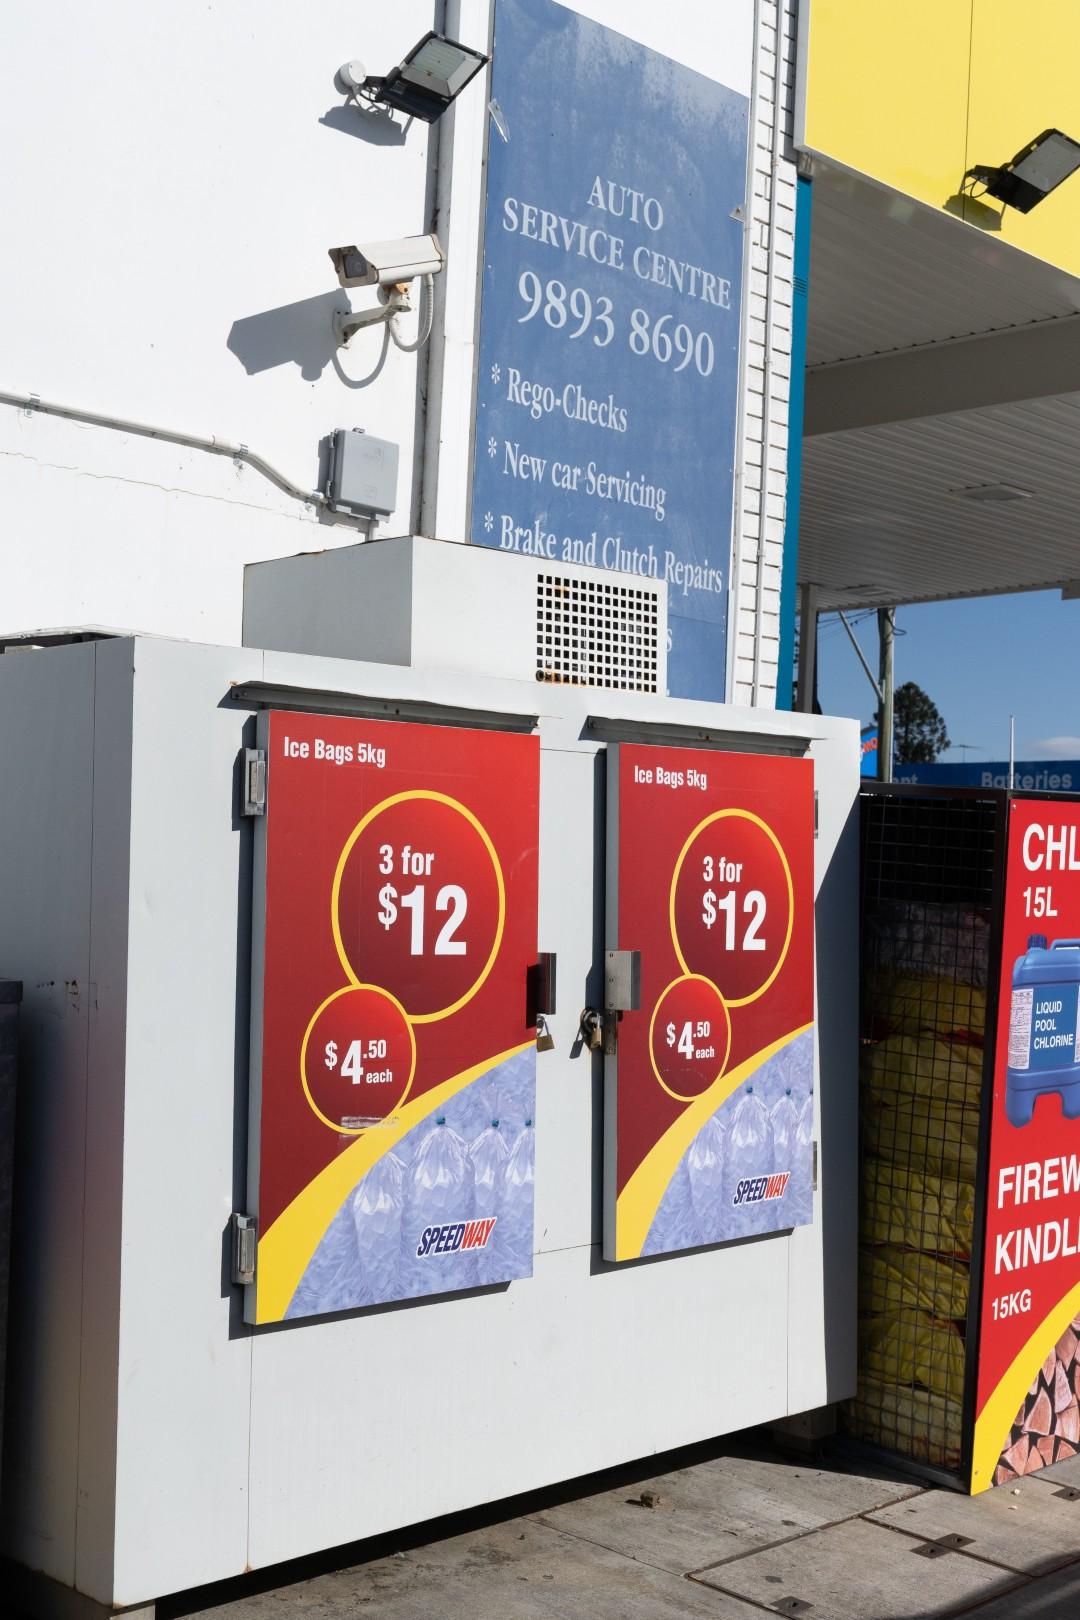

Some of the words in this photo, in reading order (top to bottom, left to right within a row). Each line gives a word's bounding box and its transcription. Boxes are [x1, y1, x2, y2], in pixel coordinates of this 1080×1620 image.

[587, 175, 664, 231] AUTO
[503, 197, 624, 271] SERVICE
[633, 246, 731, 310] CENTRE
[518, 271, 614, 347] 9893
[629, 308, 714, 377] 8690
[507, 367, 628, 433] Rego-Checks
[503, 440, 547, 483] New
[551, 461, 581, 491] car
[586, 462, 666, 521] Servicing
[500, 515, 557, 558] Brake
[562, 533, 597, 567] and
[602, 537, 658, 580] Clutch
[664, 550, 723, 595] Repairs
[284, 736, 310, 758] Ice
[314, 739, 353, 765] Bags
[357, 743, 386, 768] 5kg
[634, 765, 653, 784] Ice
[656, 767, 684, 789] Bags
[687, 769, 707, 790] 5kg
[379, 844, 394, 875] 3
[401, 845, 435, 876] for
[1022, 823, 1080, 871] CHL
[703, 855, 714, 882] 3
[719, 857, 743, 883] for
[1023, 885, 1058, 918] 15L
[377, 882, 468, 956] $12
[702, 888, 767, 951] $12
[1036, 1000, 1063, 1015] LIQUID
[1033, 1033, 1074, 1050] CHLORINE
[1034, 1018, 1057, 1032] POOL
[695, 1046, 715, 1059] each
[366, 1069, 393, 1084] each
[733, 1173, 790, 1205] SPEEDWAY
[997, 1153, 1080, 1209] FIREW
[417, 1218, 497, 1258] SPEEDWAY
[992, 1288, 1032, 1321] 15KG
